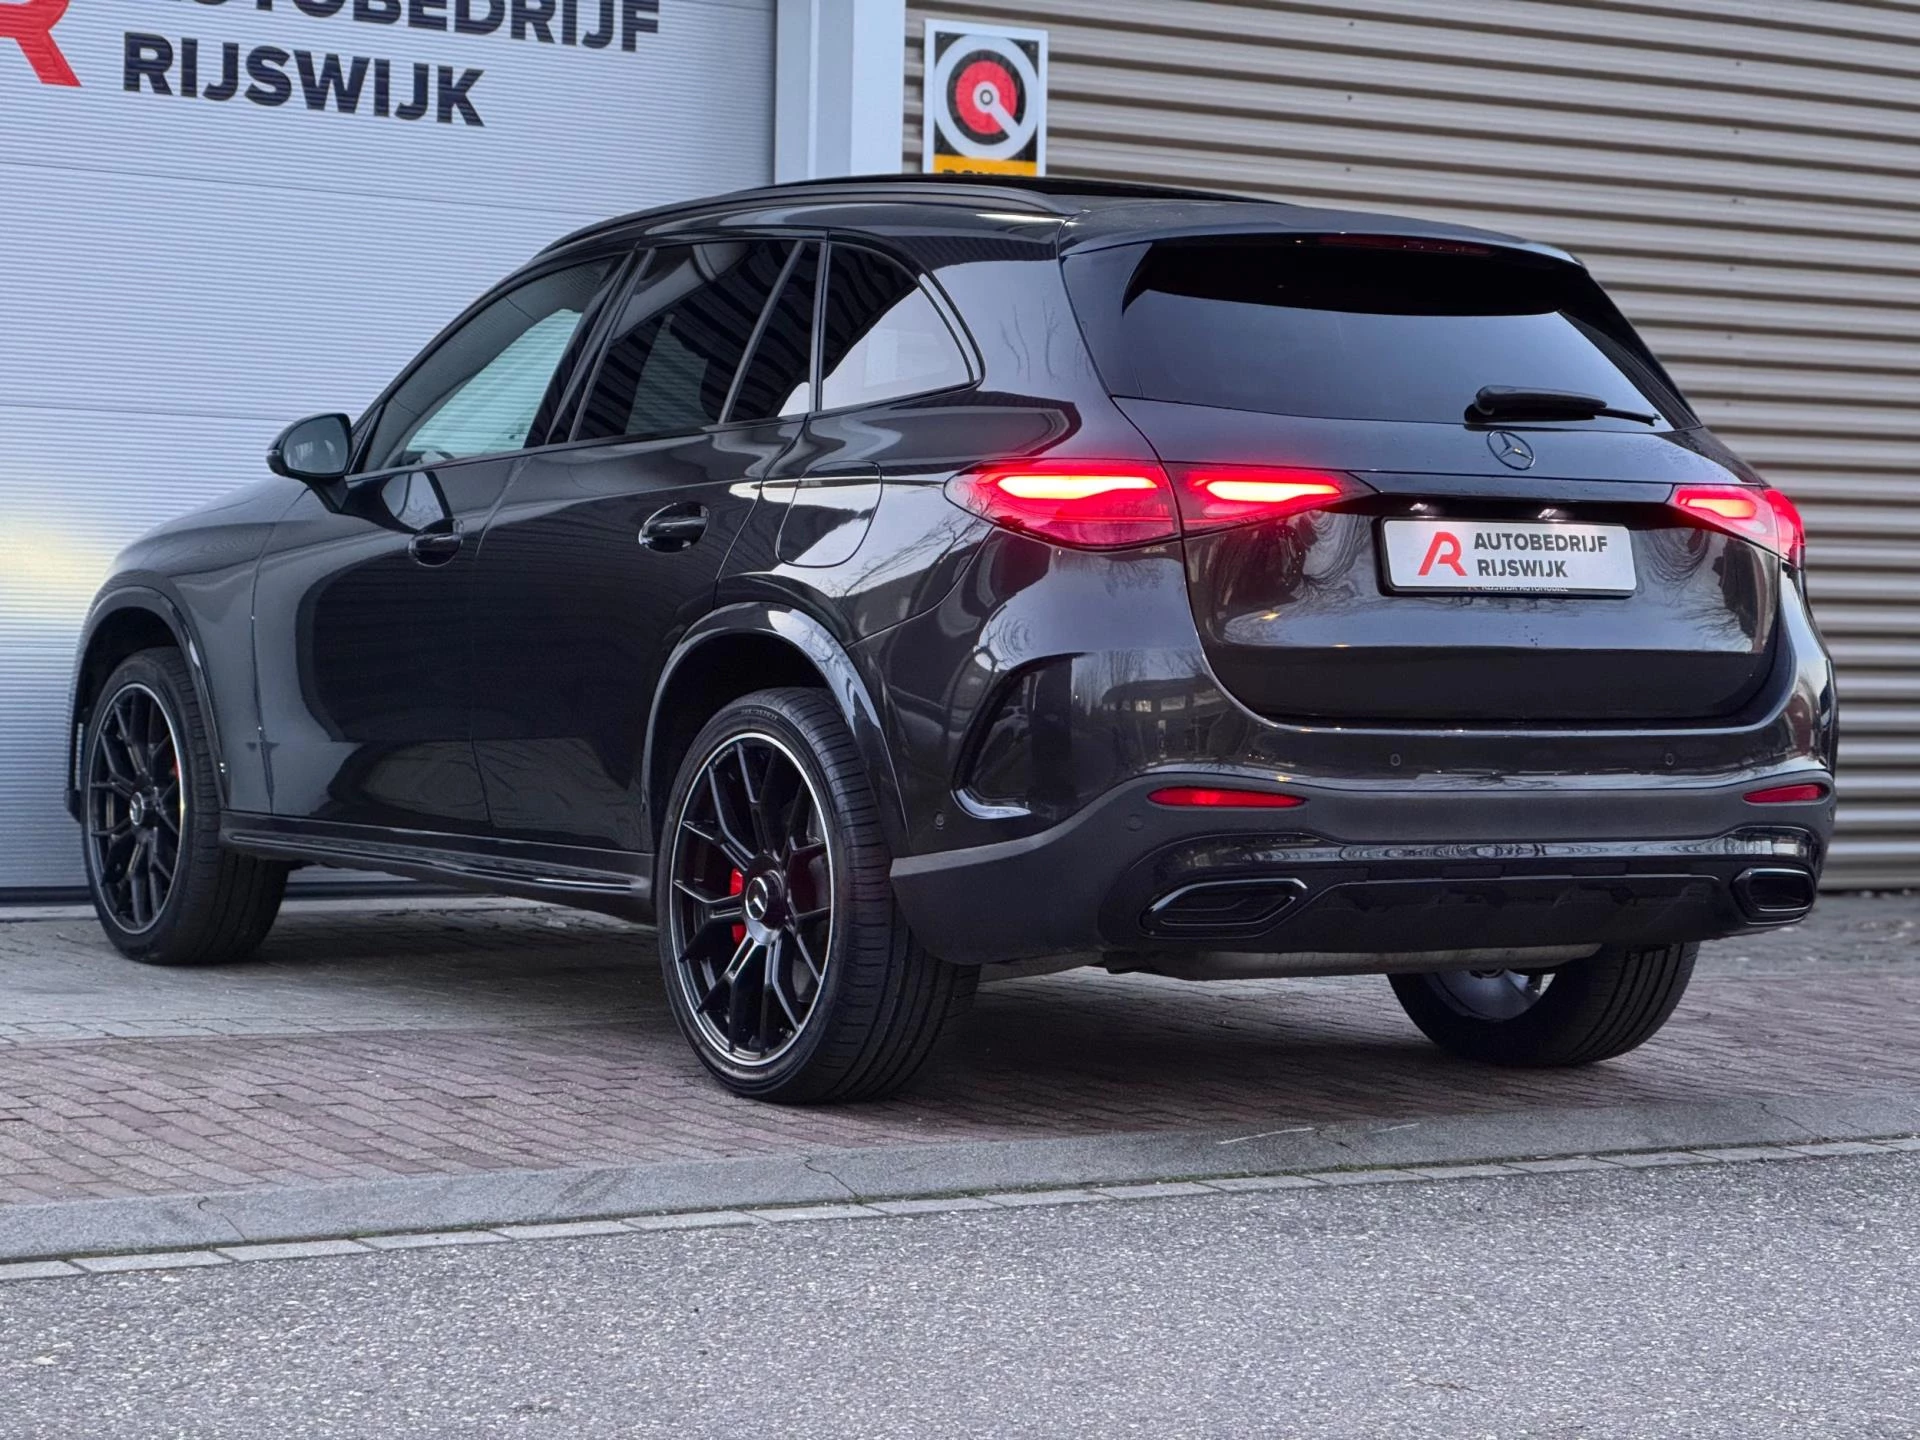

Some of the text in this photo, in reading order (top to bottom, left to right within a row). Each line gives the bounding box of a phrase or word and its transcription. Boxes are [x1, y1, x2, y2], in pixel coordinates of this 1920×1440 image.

[174, 0, 659, 52] EDRIJF
[124, 32, 485, 127] RIJSWIJK
[1474, 532, 1608, 553] AUTOBEDRIJF
[1477, 559, 1568, 578] RIJSWIJK
